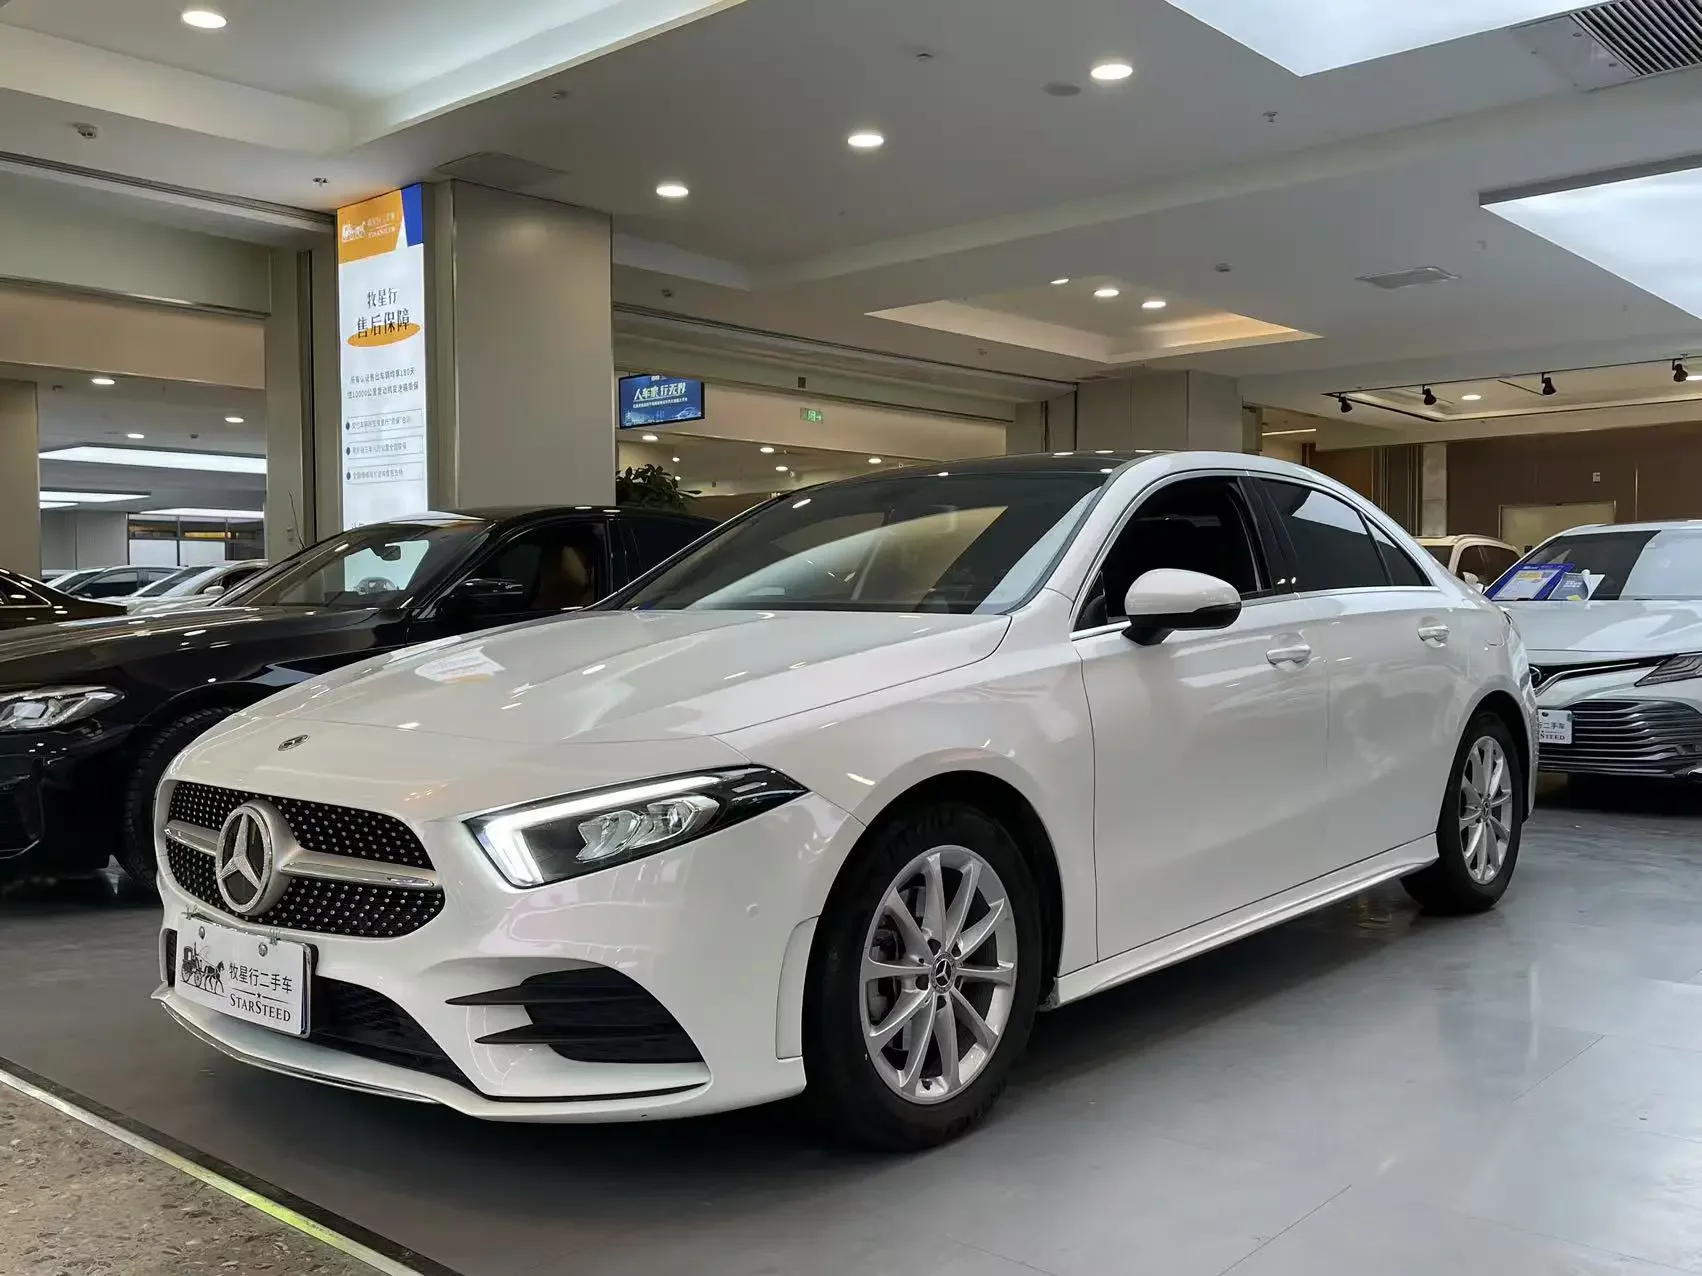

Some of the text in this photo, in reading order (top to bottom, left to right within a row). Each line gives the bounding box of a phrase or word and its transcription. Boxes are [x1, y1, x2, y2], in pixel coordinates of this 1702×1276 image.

[367, 287, 398, 308] 牧星行
[357, 307, 410, 339] 售后保障
[229, 962, 293, 994] 牧星行二手车
[230, 993, 292, 1023] STARSTEED
